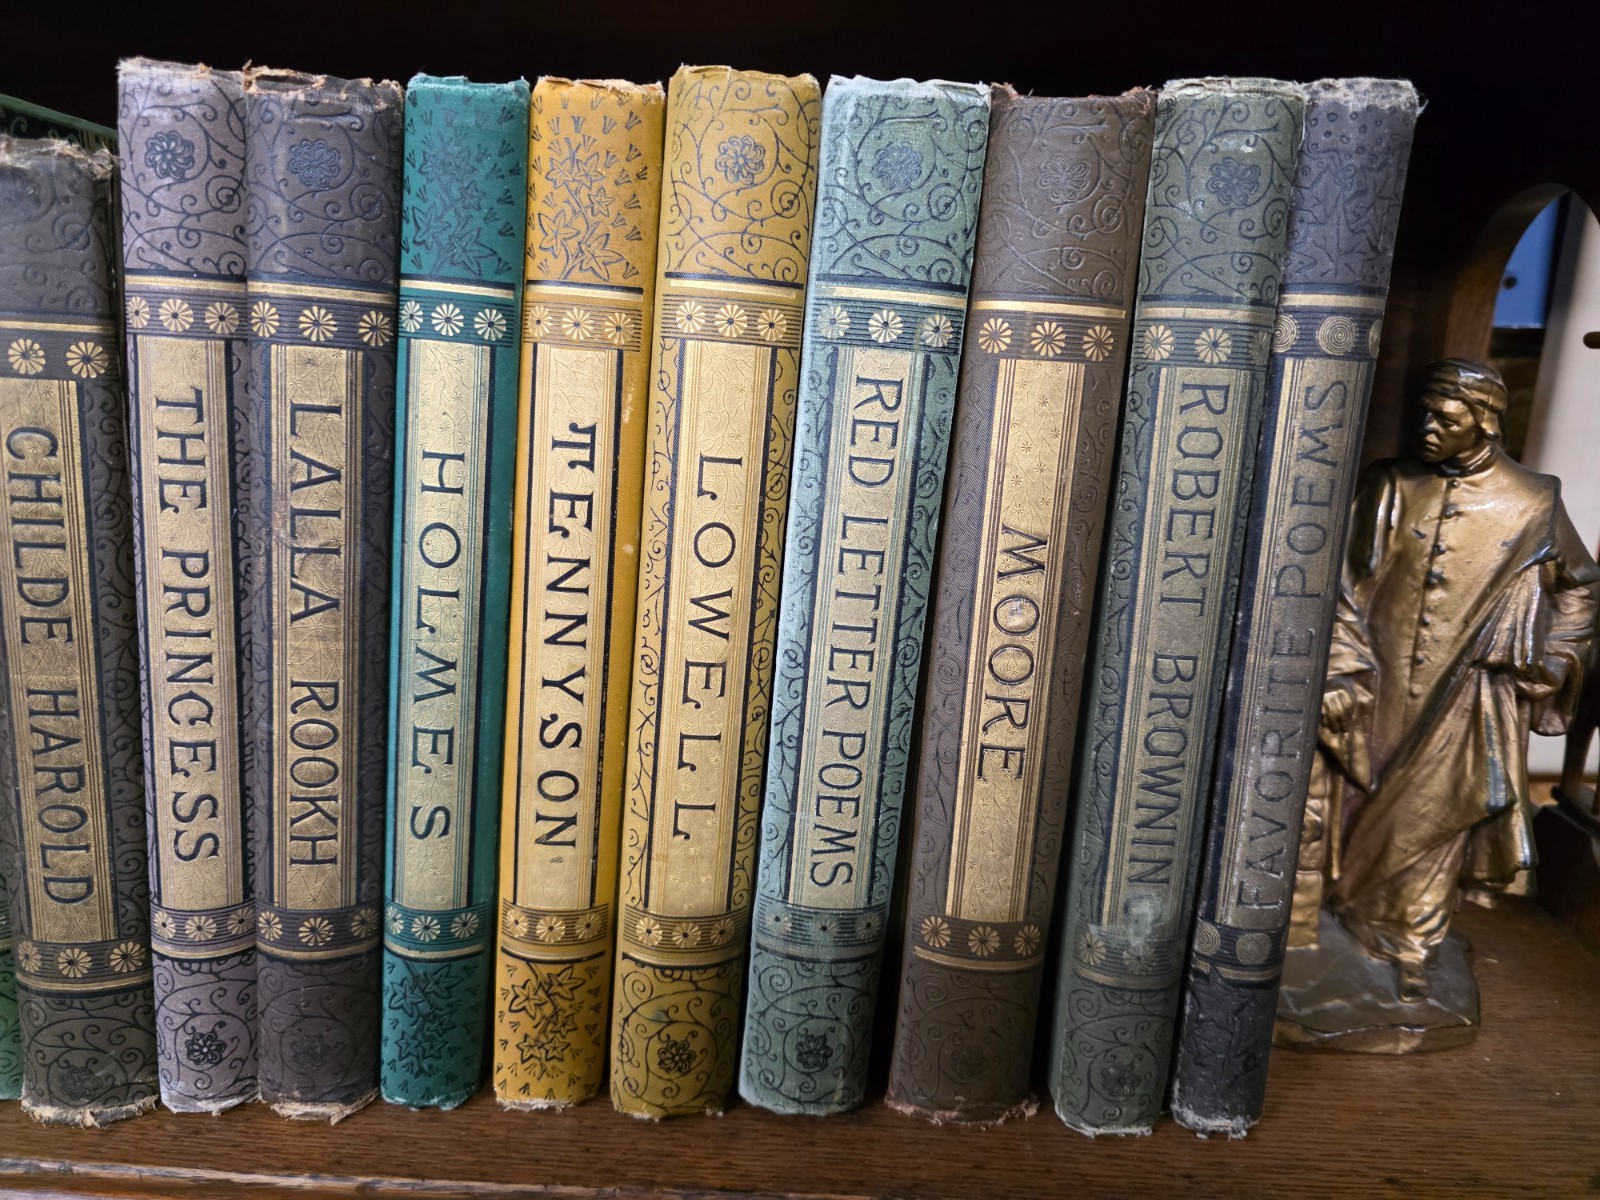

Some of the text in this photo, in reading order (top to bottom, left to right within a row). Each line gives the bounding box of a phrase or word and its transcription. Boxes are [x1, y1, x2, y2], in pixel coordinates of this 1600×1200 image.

[6, 426, 94, 904] CHILDE HAROLD
[155, 386, 220, 862] THE PRINCESS
[290, 400, 343, 865] LALLA ROOKH
[410, 449, 466, 840] HOLMES
[535, 422, 597, 848] TENNYSON
[672, 453, 743, 840] LOWELL
[810, 374, 904, 888] RED LETTER POEMS
[976, 522, 1049, 781] MOORE
[1159, 382, 1231, 617] ROBERT
[1236, 380, 1348, 911] FAVORITE POEMS
